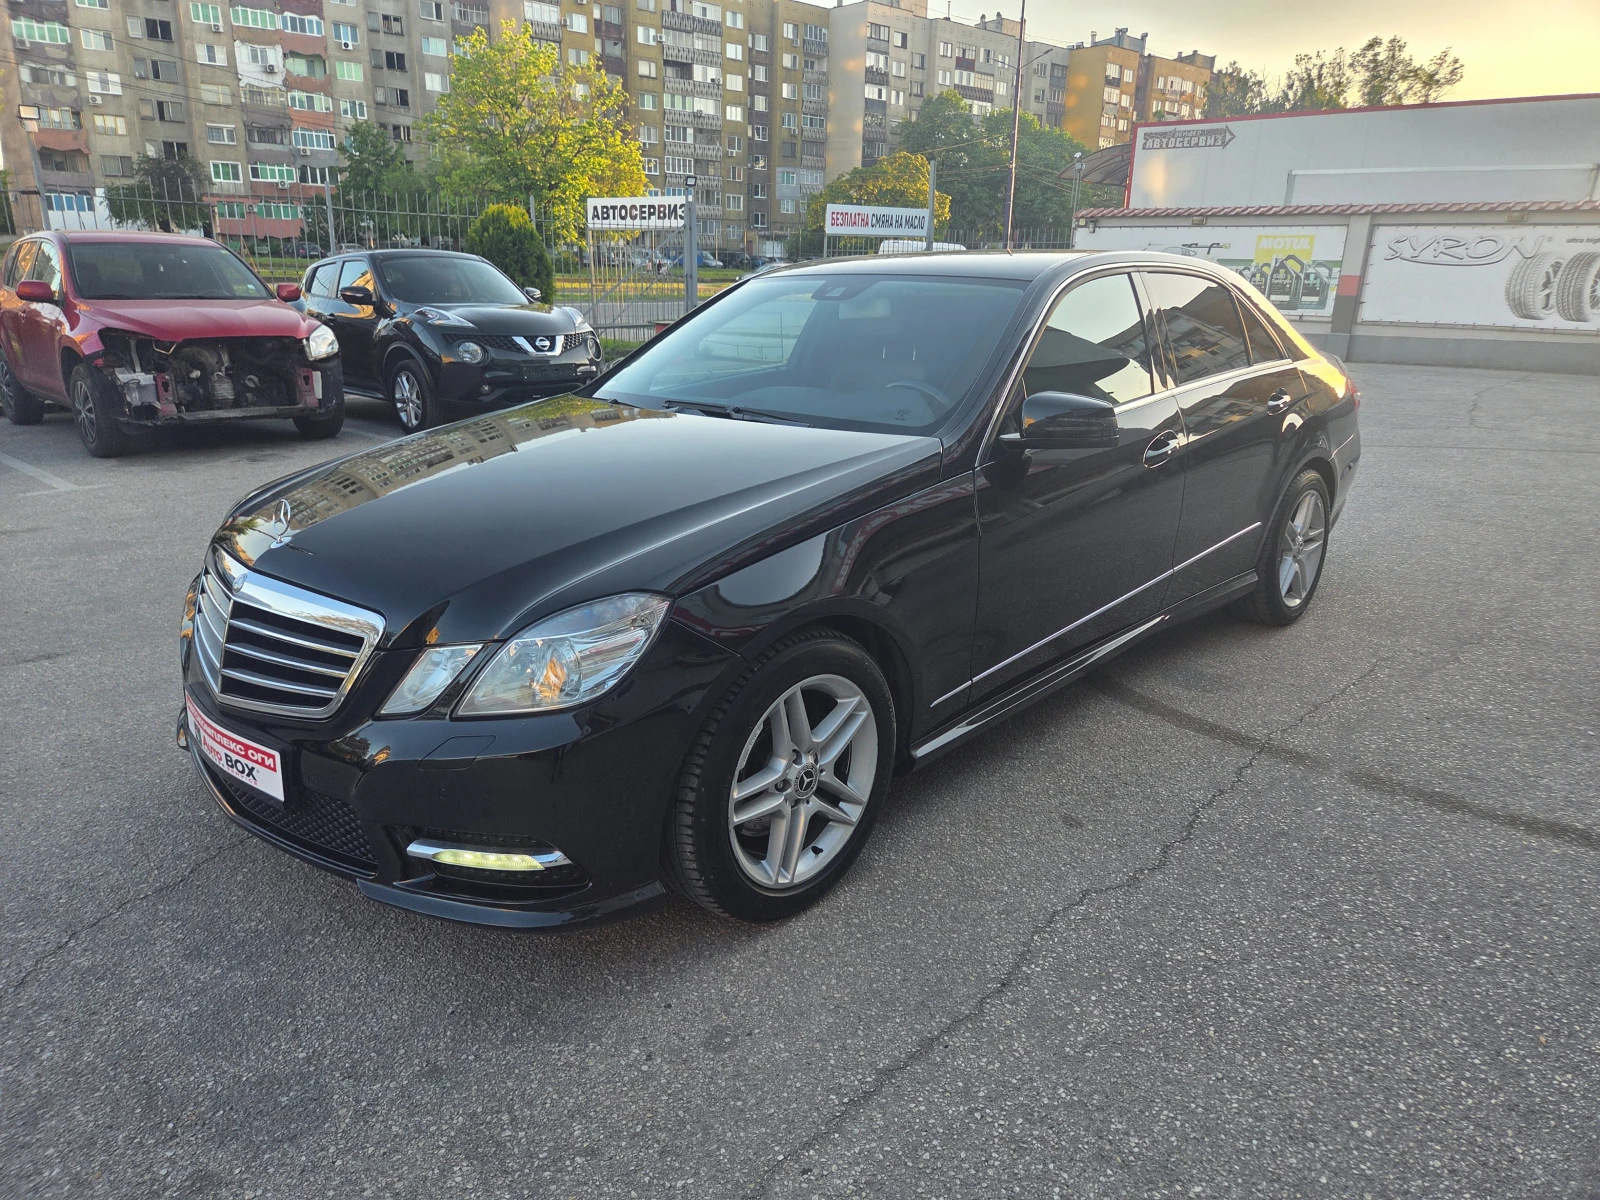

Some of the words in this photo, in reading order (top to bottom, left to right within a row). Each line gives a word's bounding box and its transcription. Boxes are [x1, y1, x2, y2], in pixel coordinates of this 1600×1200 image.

[1144, 133, 1223, 149] АВТОСЕРВИЗ
[591, 203, 686, 221] АВТОСЕРВИЗ
[830, 211, 870, 228] БЕЗПЛАТНА
[870, 213, 894, 229] СМЯНА
[894, 214, 903, 229] НА
[903, 215, 926, 230] МАСЛО
[1258, 237, 1312, 250] MOTUL
[1384, 235, 1546, 261] SYRON
[224, 752, 258, 781] BOX
[247, 749, 275, 768] ОГИ
